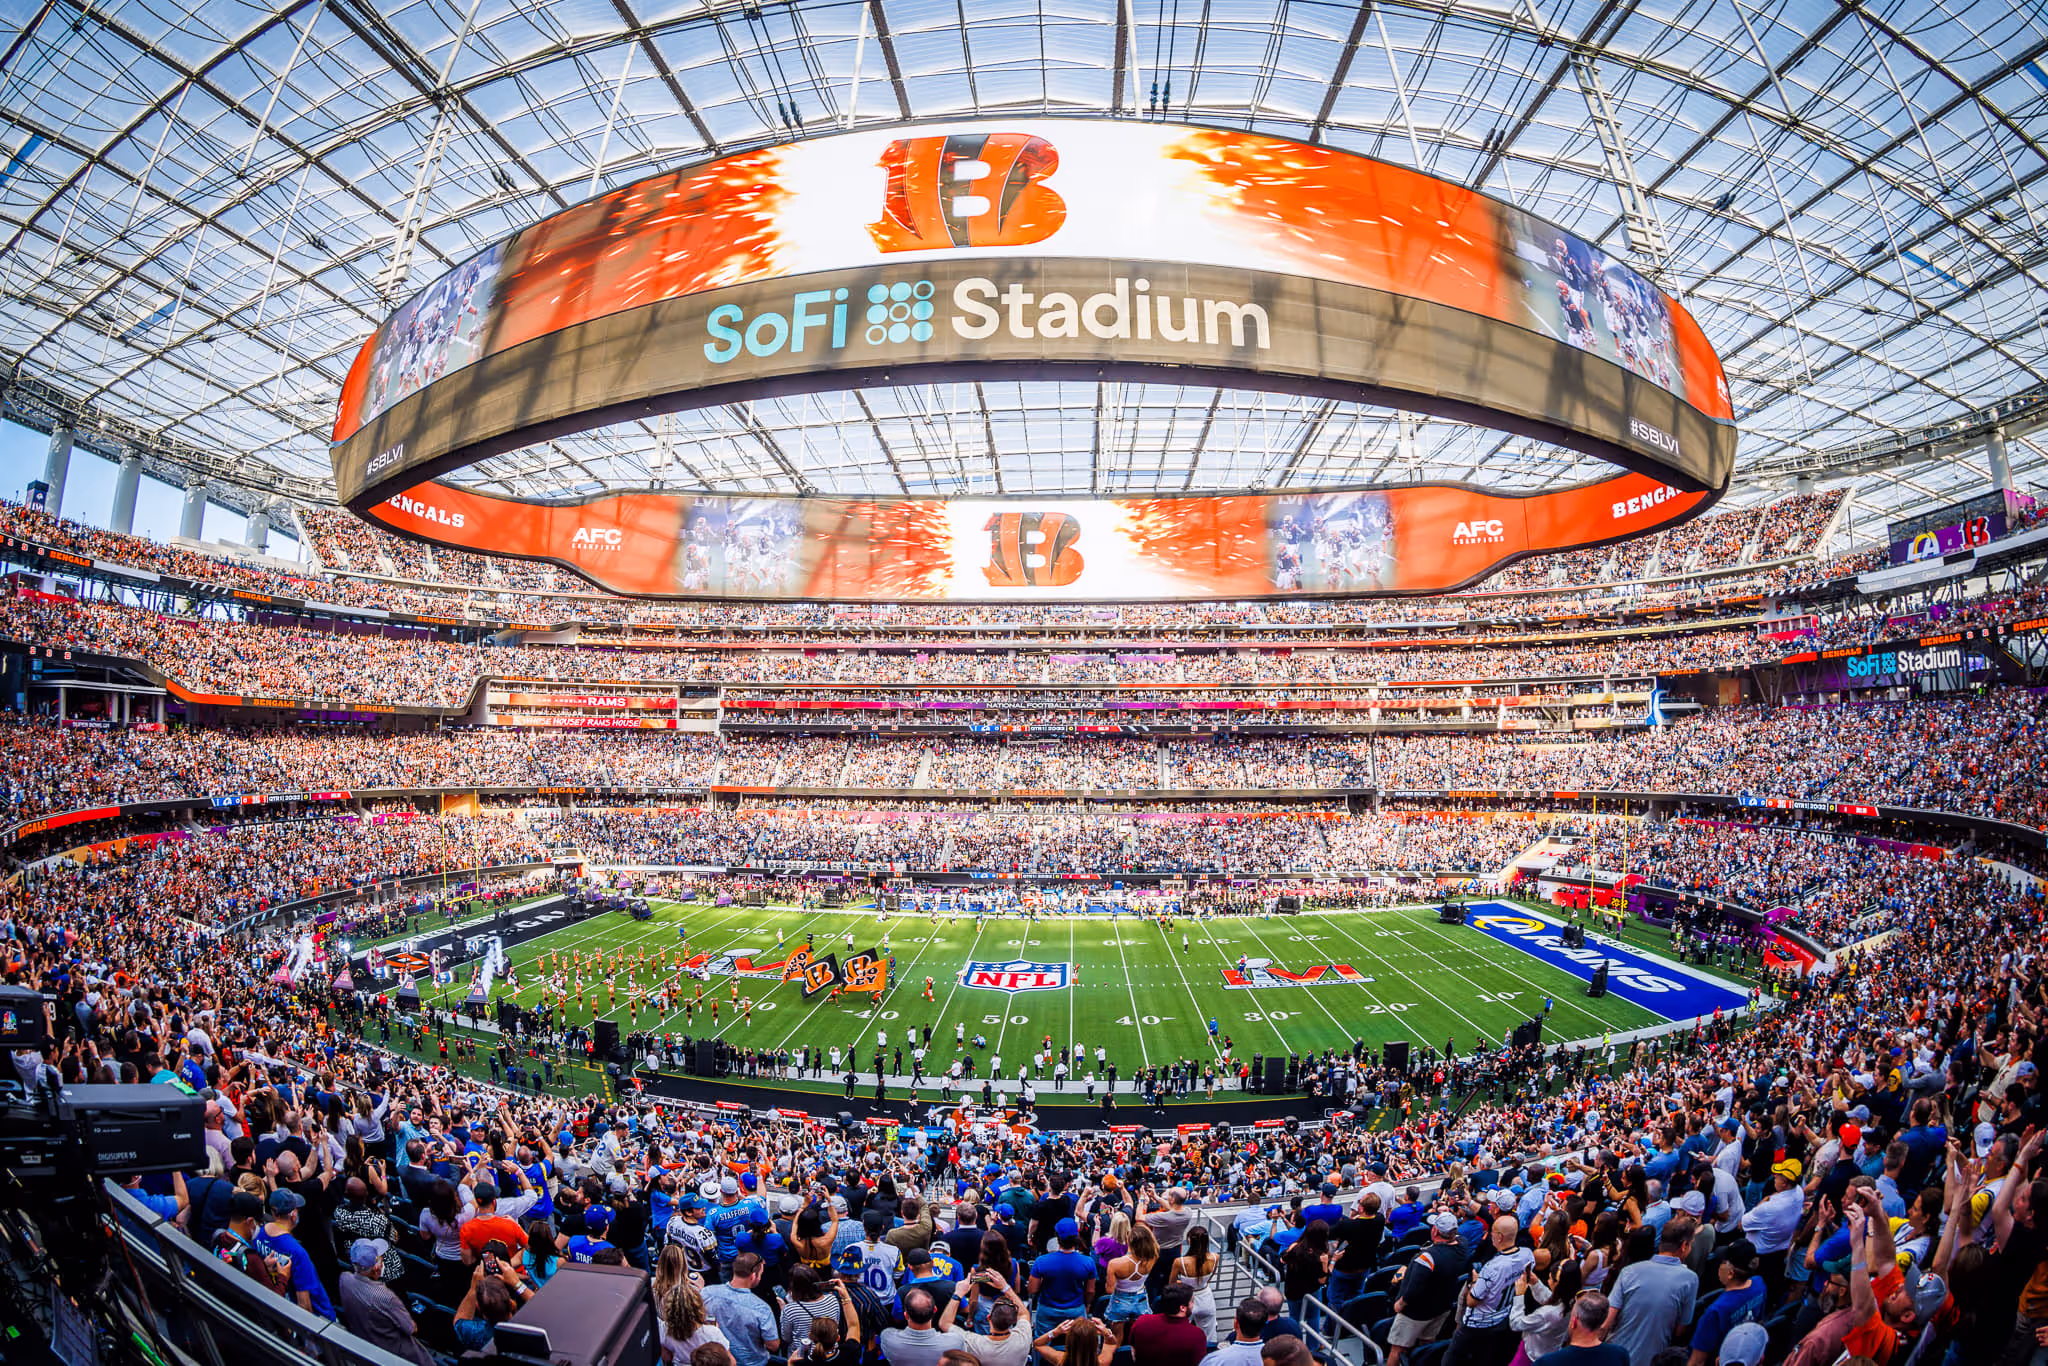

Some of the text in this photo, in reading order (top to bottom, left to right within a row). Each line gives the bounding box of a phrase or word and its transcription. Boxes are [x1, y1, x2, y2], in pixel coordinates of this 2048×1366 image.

[703, 277, 1270, 364] SoFi Stadium
[1630, 420, 1680, 455] #SBLVI
[366, 443, 404, 475] #SBLVI
[1612, 486, 1684, 519] BENGA
[385, 494, 465, 528] ENGALS
[1453, 519, 1503, 538] AFC
[572, 527, 622, 544] AFC
[50, 551, 91, 567] BENGALS
[234, 591, 271, 602] BENGALS
[1724, 593, 1764, 603] BENGALS
[417, 616, 456, 625] BENGALS
[1920, 633, 1961, 647] BENGALS
[1822, 647, 1862, 658] BENGALS
[1847, 647, 1961, 677] SoFi Stadium
[1659, 668, 1700, 676] BENGALS
[253, 699, 295, 708] BENGALS
[588, 697, 626, 707] RAMS
[354, 705, 395, 713] BENGALS
[552, 718, 585, 727] HOUSE?
[587, 718, 611, 727] RAMS
[612, 719, 642, 727] HOUSE!
[1520, 936, 1687, 993] RAMS
[973, 971, 1057, 988] NFL
[1475, 991, 1517, 1003] 10
[853, 1009, 900, 1020] 40
[1364, 1003, 1409, 1014] 20
[981, 1014, 1030, 1025] 50
[1115, 1014, 1161, 1025] 40
[1244, 1010, 1289, 1022] 30
[98, 1151, 137, 1160] DIGISUPER 95
[719, 1206, 750, 1221] STAFFORD
[698, 1228, 713, 1241] 39
[575, 1251, 593, 1264] STAF
[864, 1256, 881, 1266] KUPP
[932, 1257, 953, 1276] MS
[863, 1268, 888, 1292] 10
